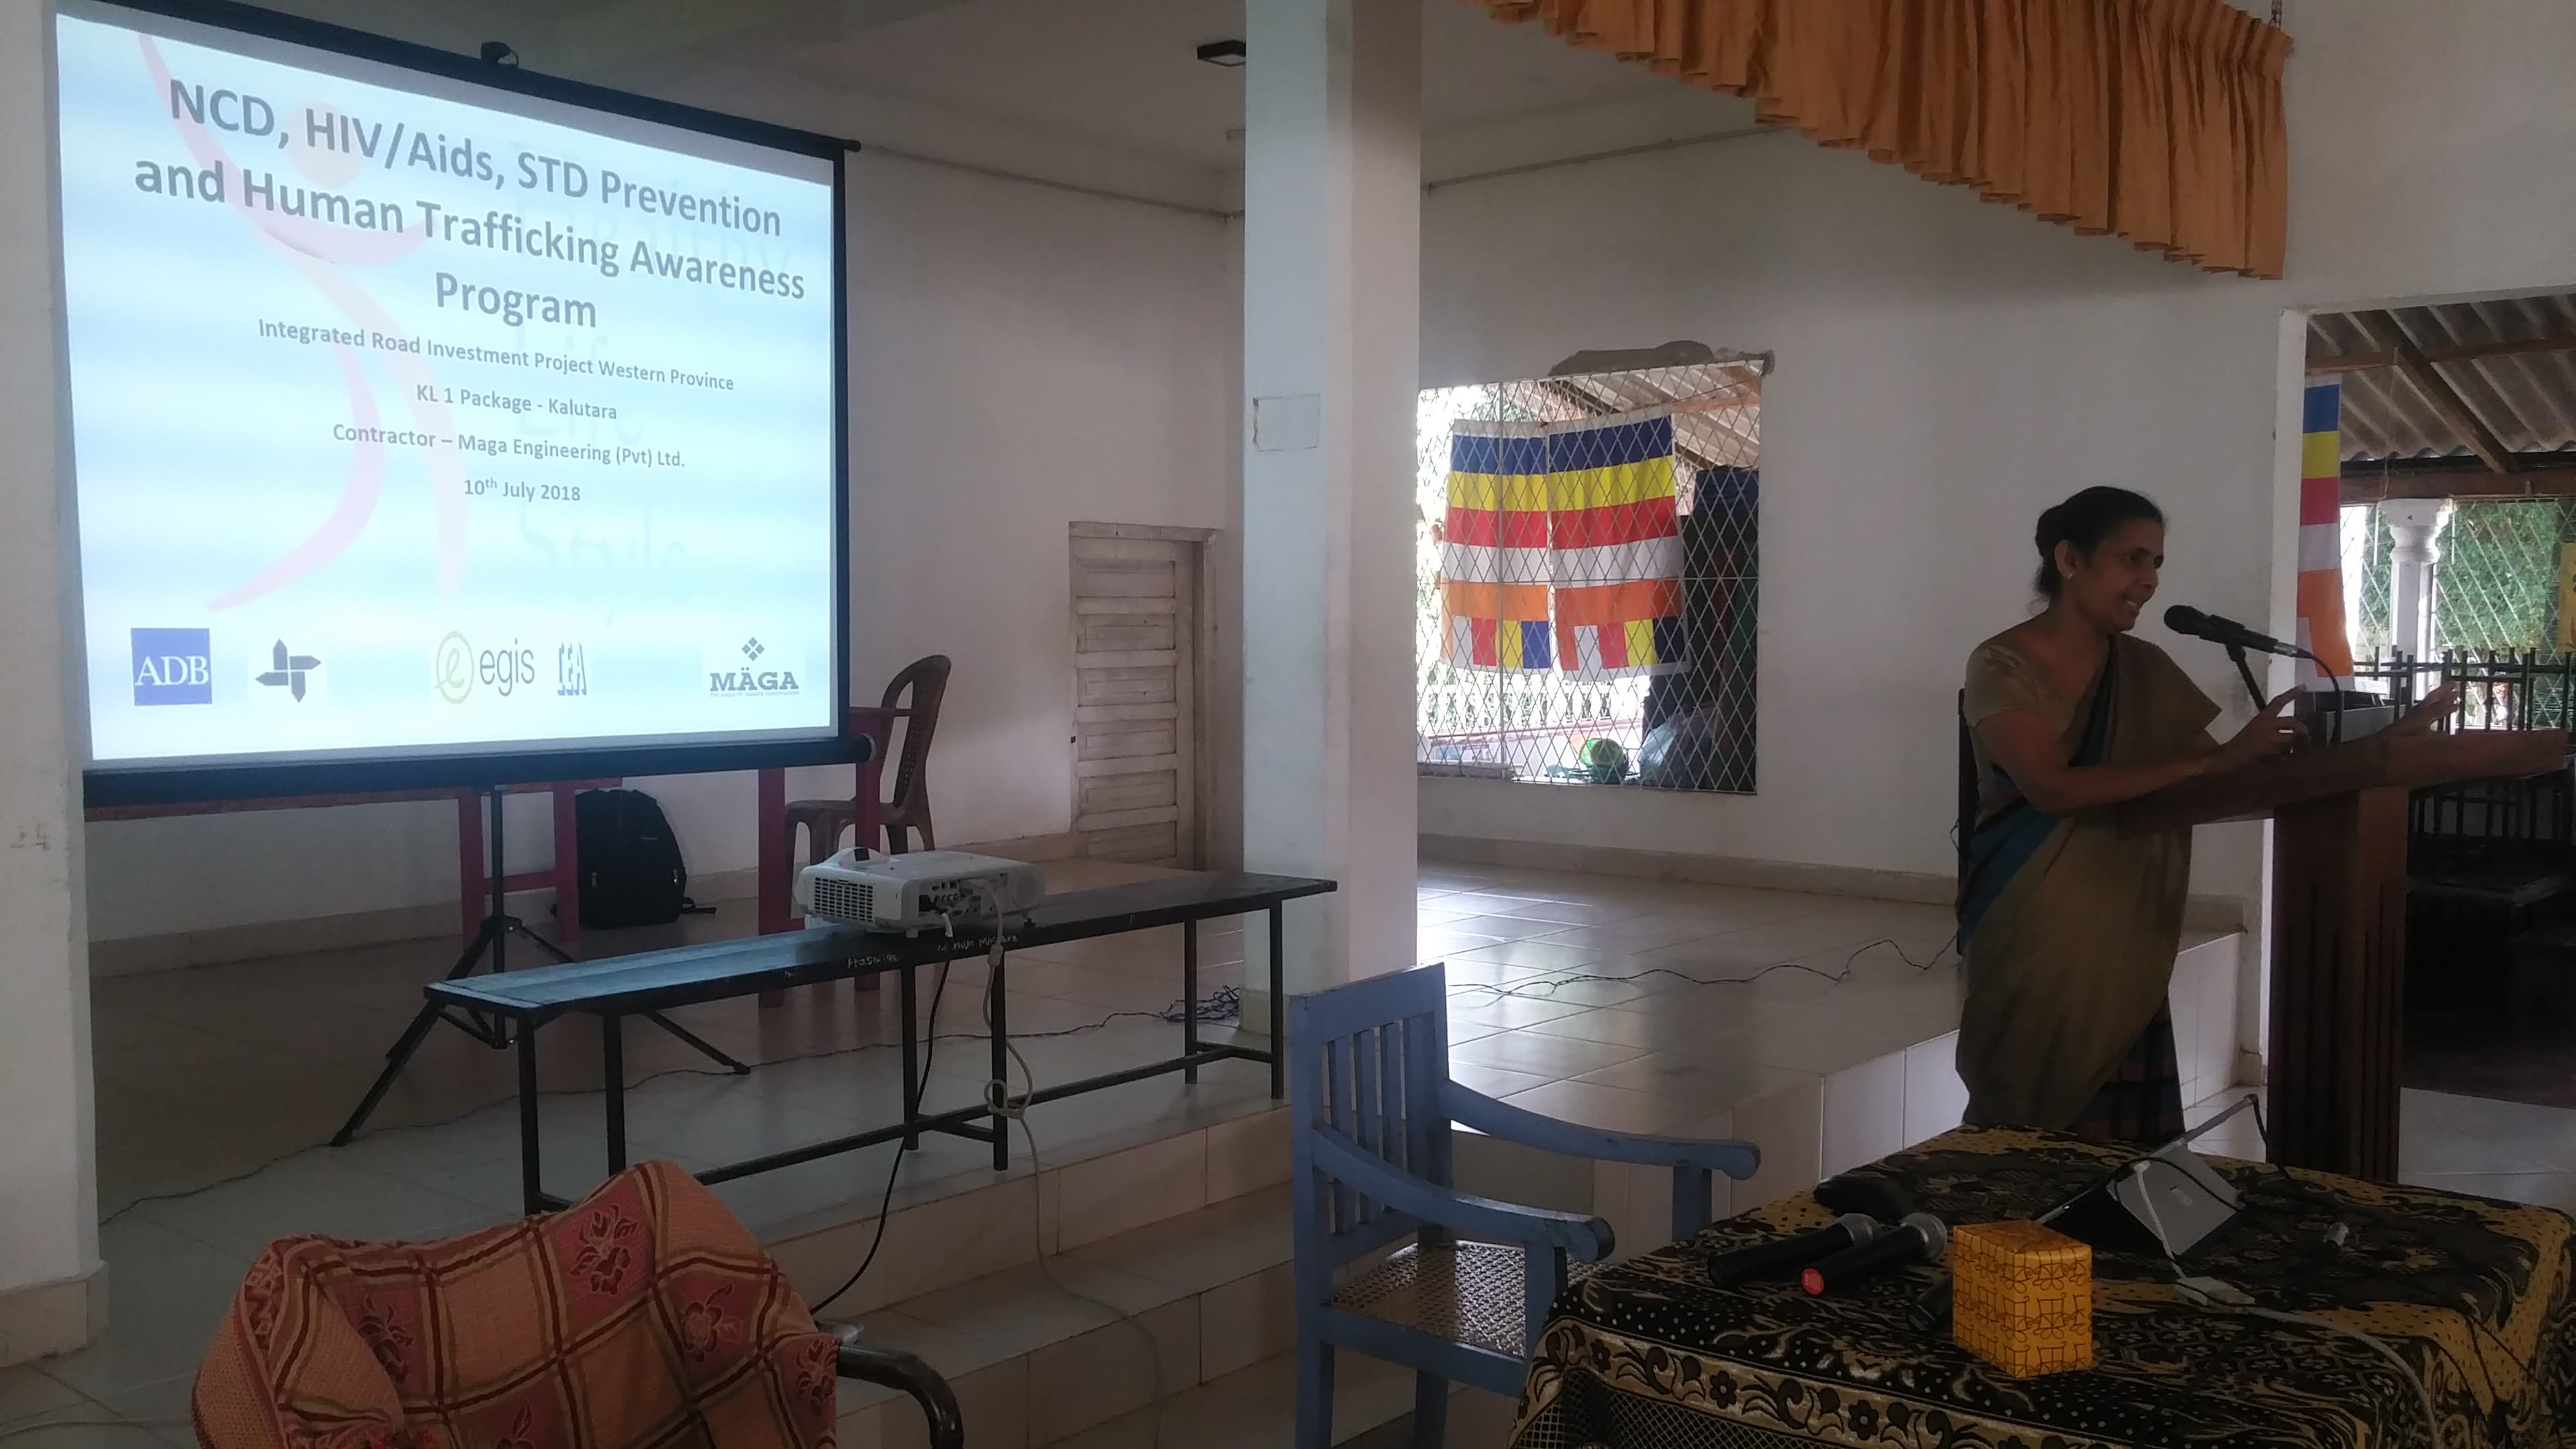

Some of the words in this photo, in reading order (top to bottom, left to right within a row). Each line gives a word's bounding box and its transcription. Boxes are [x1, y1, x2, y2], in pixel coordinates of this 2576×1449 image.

[170, 79, 288, 150] NCD,
[306, 107, 504, 191] HIV/Aids,
[518, 152, 588, 197] STD
[602, 170, 781, 237] Prevention
[136, 160, 225, 203] and
[244, 169, 403, 233] Human
[417, 201, 619, 278] Trafficking
[631, 240, 805, 299] Awareness
[435, 271, 596, 328] Program
[259, 319, 366, 346] Integrated
[372, 332, 421, 354] Road
[427, 340, 529, 367] Investment
[535, 352, 594, 375] Project
[598, 360, 665, 383] Western
[670, 369, 735, 390] Province
[417, 384, 439, 402] KL
[443, 387, 454, 404] 1
[460, 389, 532, 414] Package
[549, 398, 617, 420] Kalutara
[333, 423, 437, 447] Contractor
[458, 433, 507, 456] Maga
[513, 439, 611, 465] Engineering
[616, 446, 653, 468] (Pvt)
[657, 450, 686, 468] Ltd.
[464, 477, 498, 496] 10th
[502, 481, 536, 503] July
[540, 484, 582, 502] 2018
[133, 655, 209, 687] ADB
[480, 637, 535, 697] egis
[710, 666, 800, 692] MÄGA
